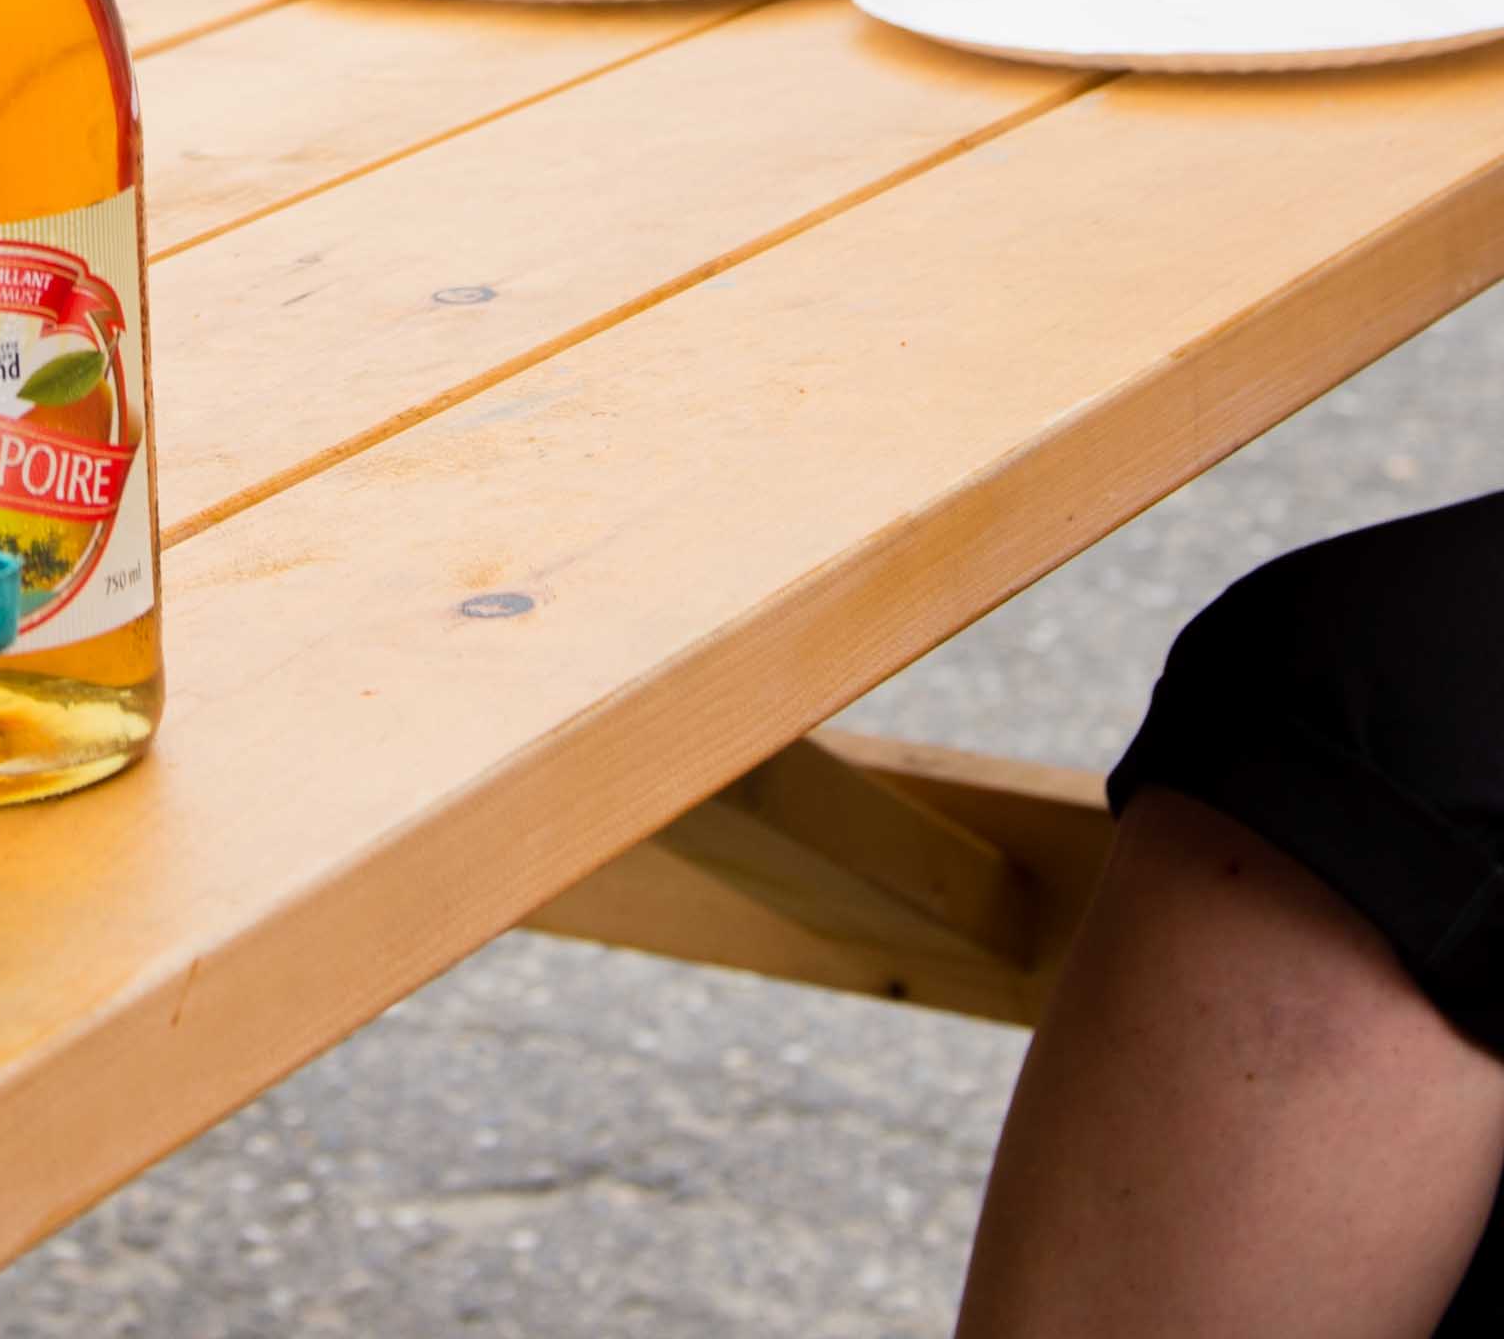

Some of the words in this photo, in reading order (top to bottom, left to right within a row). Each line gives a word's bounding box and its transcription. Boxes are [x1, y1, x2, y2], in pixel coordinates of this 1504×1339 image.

[0, 285, 43, 306] MUST
[104, 569, 127, 596] 750
[127, 557, 143, 588] ml
